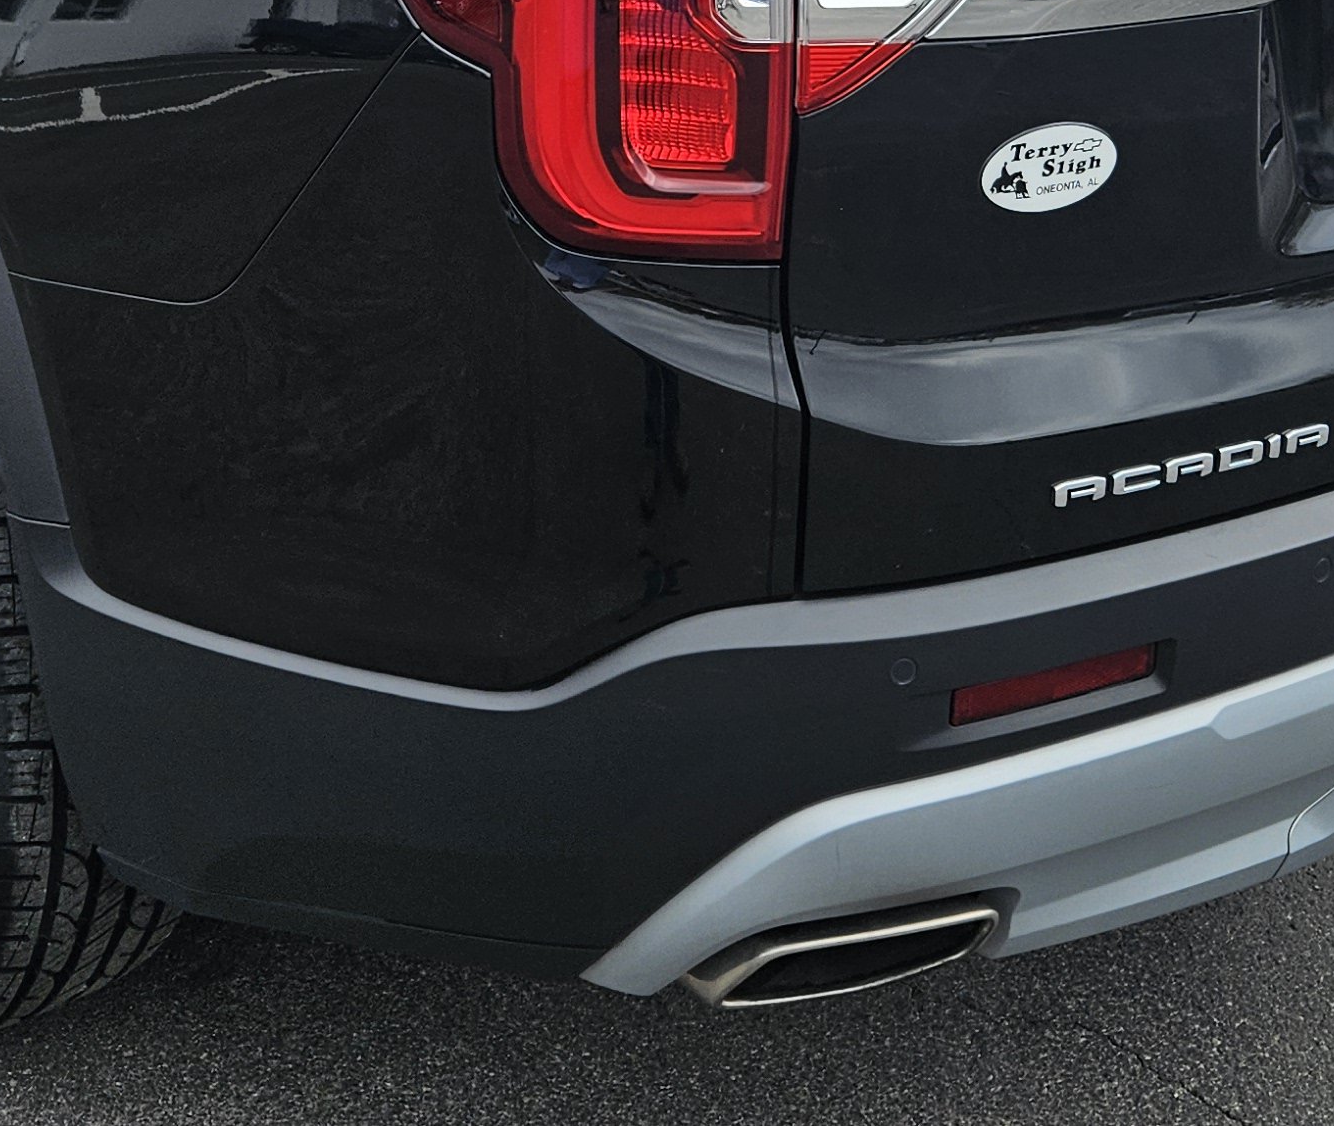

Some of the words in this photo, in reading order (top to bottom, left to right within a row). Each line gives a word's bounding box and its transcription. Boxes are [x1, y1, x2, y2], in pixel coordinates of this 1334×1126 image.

[1010, 143, 1073, 163] Terry
[1041, 156, 1102, 177] Sligh
[1087, 178, 1100, 187] AL
[1051, 423, 1330, 508] ACADIA
